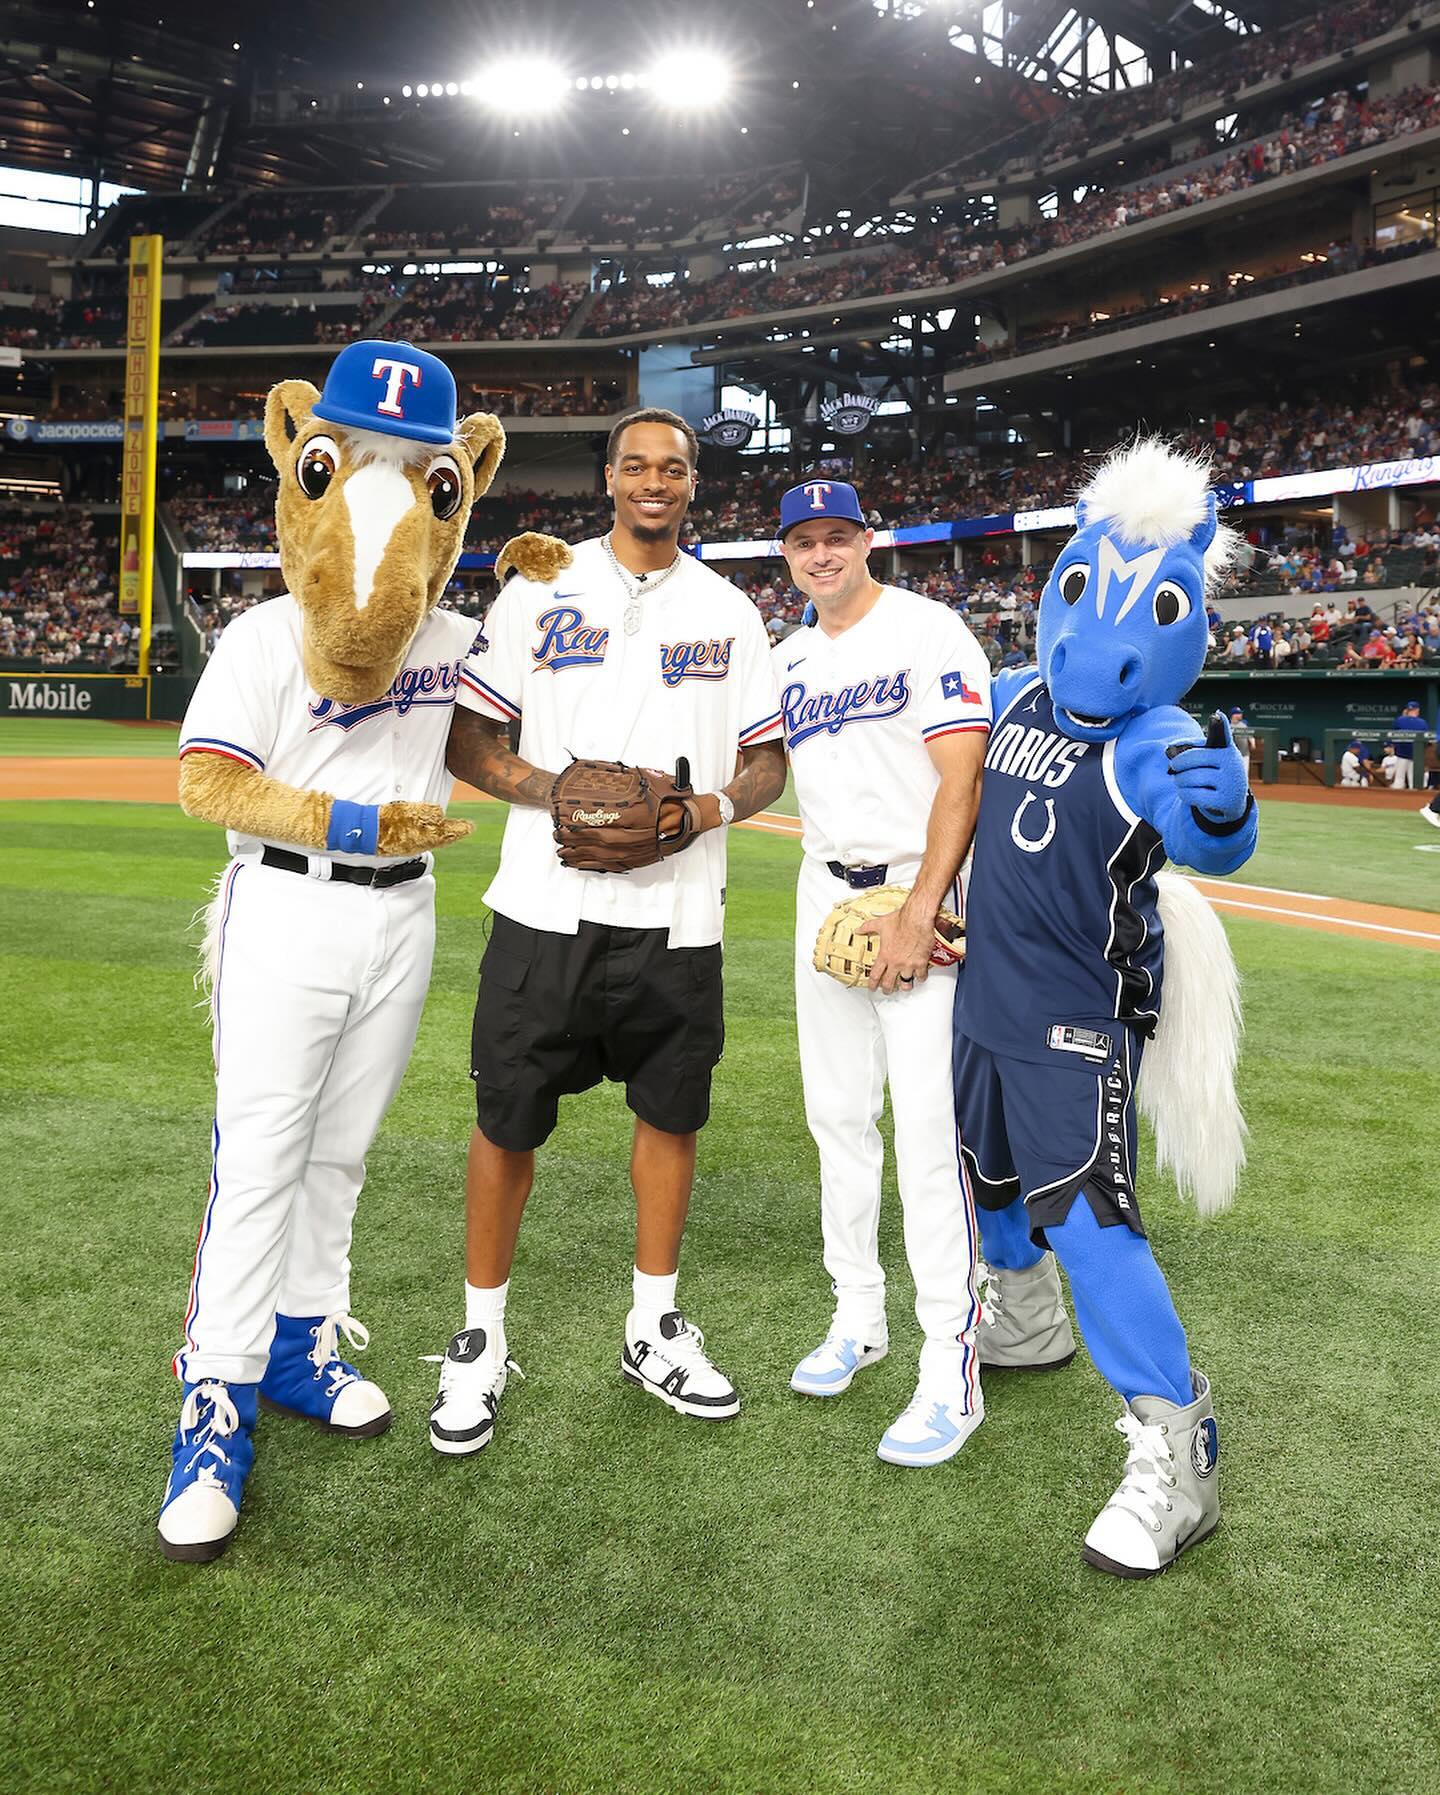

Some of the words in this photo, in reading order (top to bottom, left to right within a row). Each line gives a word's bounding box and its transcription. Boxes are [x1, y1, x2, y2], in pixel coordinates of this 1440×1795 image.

[133, 276, 144, 337] THE
[132, 358, 142, 415] HOT
[372, 358, 421, 418] T
[821, 397, 843, 418] JACK
[703, 411, 724, 431] JACK
[129, 433, 139, 513] ZONE
[1352, 456, 1436, 492] Rangers
[804, 483, 831, 511] T
[1096, 535, 1167, 626] M
[781, 669, 912, 750] Rangers
[1249, 702, 1296, 711] CHOCTAW
[1346, 703, 1398, 713] CHOCTAW
[983, 722, 1090, 788] MAVS
[571, 808, 622, 827] Rawlings
